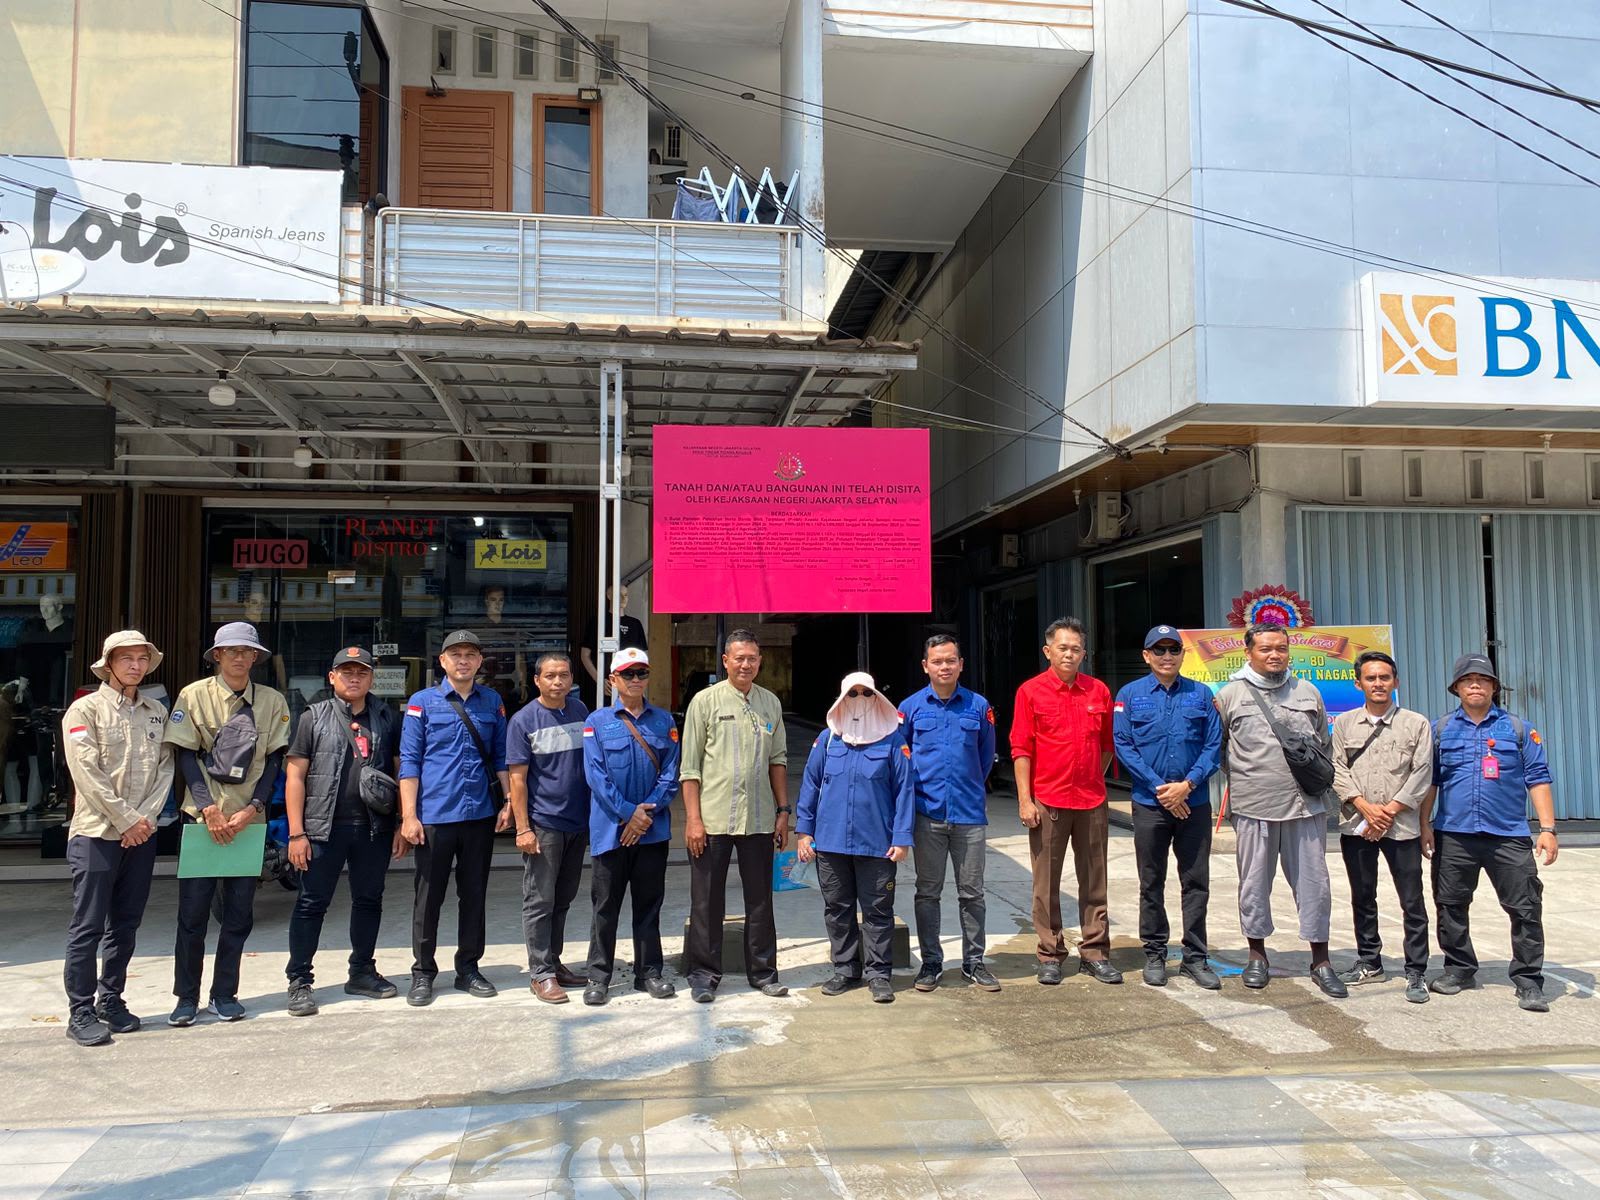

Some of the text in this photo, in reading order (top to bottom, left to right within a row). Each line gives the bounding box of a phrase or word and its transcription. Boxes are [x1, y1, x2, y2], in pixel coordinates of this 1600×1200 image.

[32, 187, 190, 266] Lois
[208, 224, 326, 242] Spanish Jeans
[664, 483, 921, 494] TANAH DAN/ATAU BANGUNAN INI TELAH DISITA
[685, 495, 898, 505] OLEH KEJAKSAAN NEGERI JAKARTA SELATAN
[346, 518, 439, 537] PLANET
[236, 543, 305, 564] HUGO
[353, 541, 428, 557] DISTRO
[501, 543, 542, 560] Lois
[12, 556, 43, 566] Lea
[1310, 655, 1326, 668] 80
[1316, 669, 1357, 681] NAGAR
[149, 716, 162, 724] ZN
